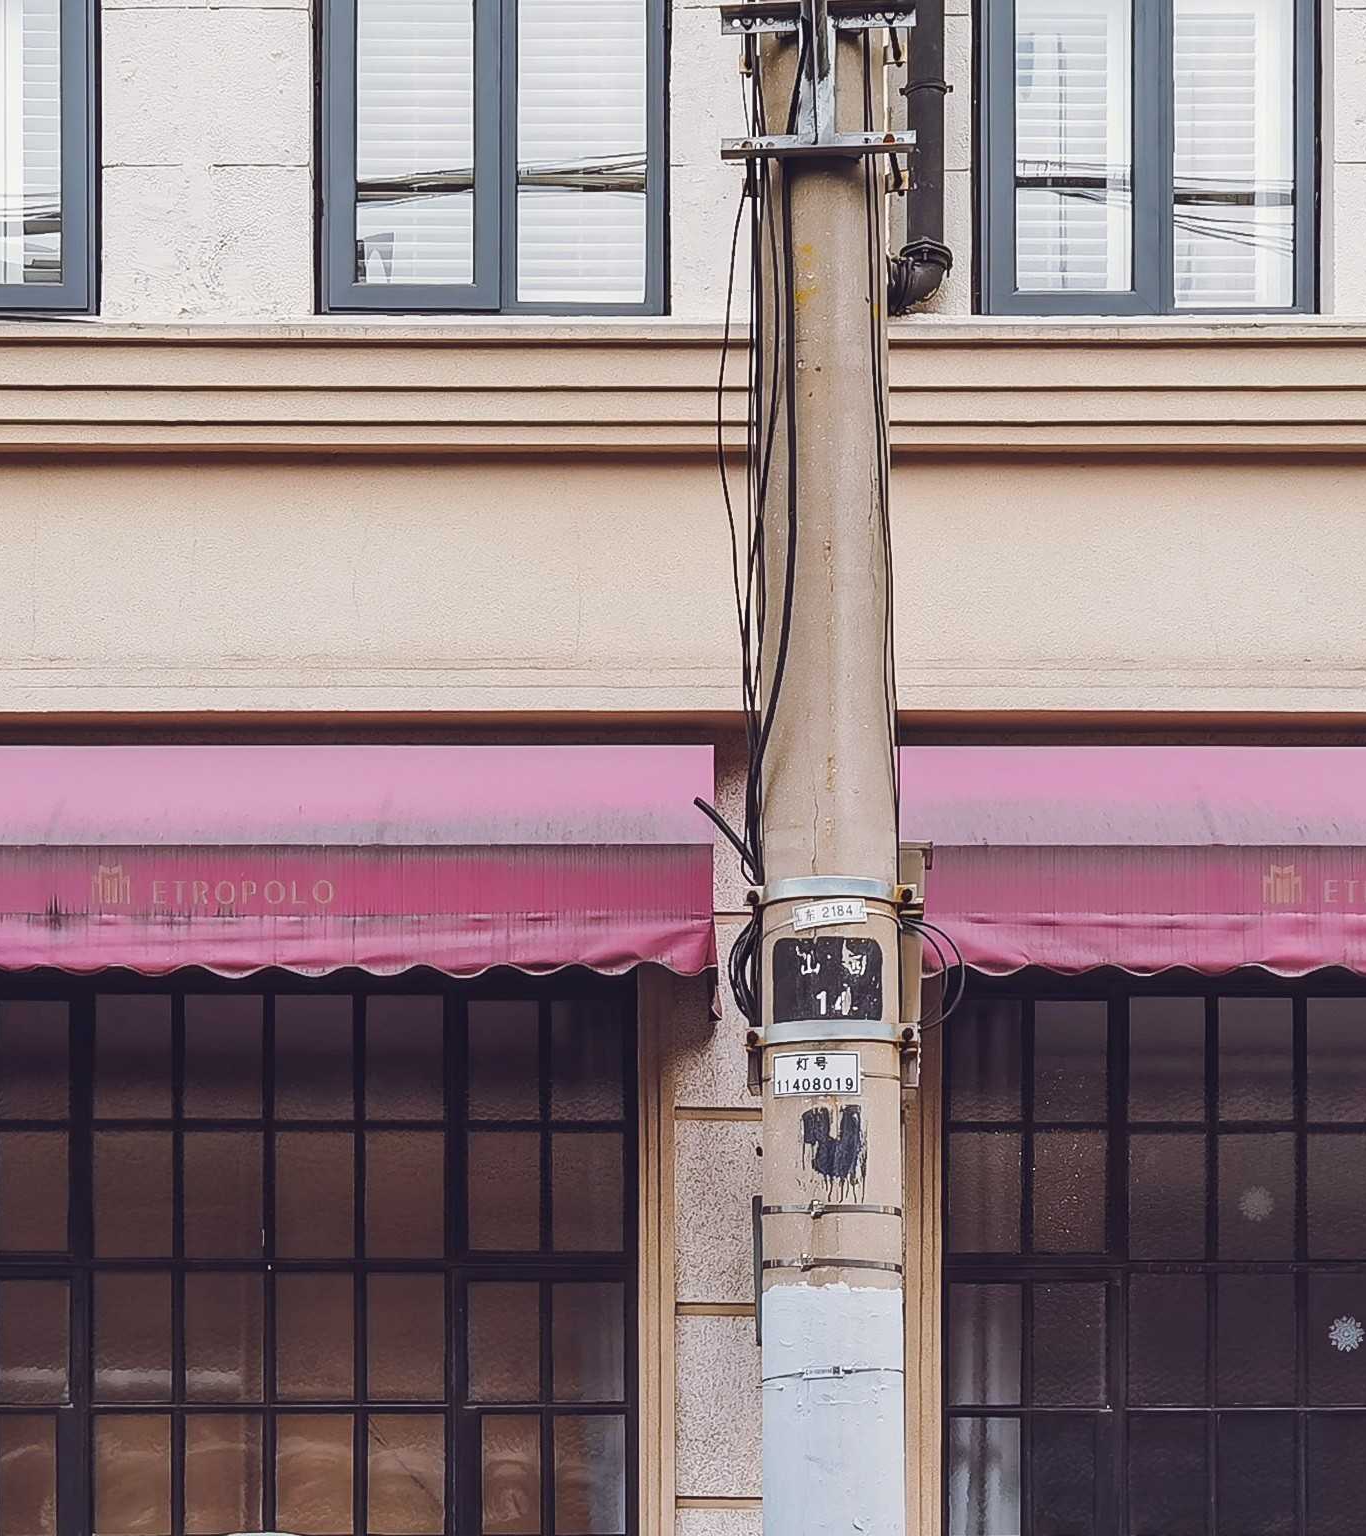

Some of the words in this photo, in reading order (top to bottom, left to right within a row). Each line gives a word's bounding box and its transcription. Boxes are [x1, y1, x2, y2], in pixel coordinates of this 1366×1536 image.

[821, 904, 853, 919] 2184
[796, 1056, 828, 1071] 灯号
[777, 1077, 854, 1093] 11408019
